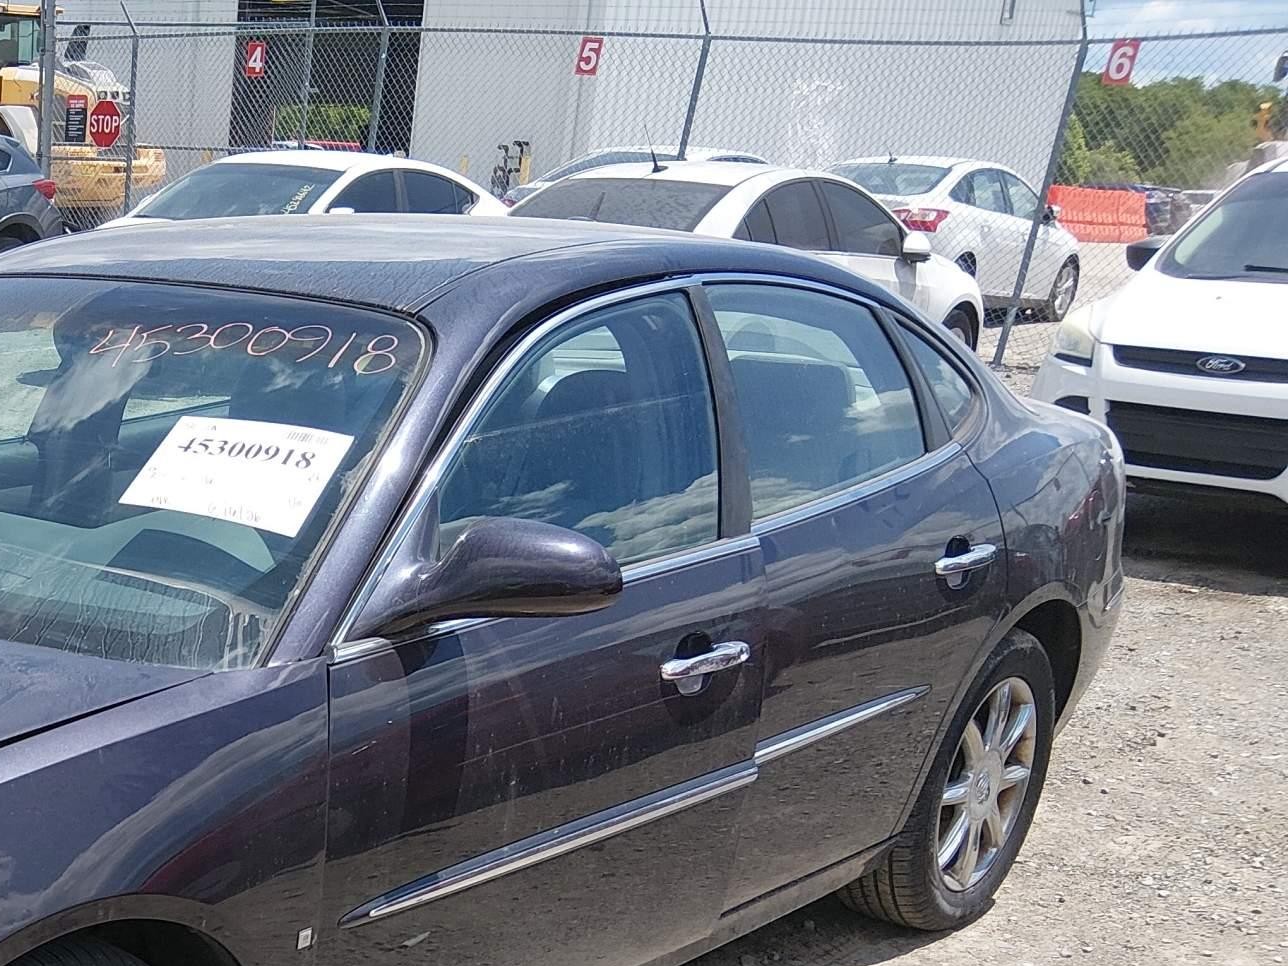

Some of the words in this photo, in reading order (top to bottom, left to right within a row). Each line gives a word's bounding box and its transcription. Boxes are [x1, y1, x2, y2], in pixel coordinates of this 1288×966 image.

[248, 46, 263, 73] 4
[579, 42, 600, 71] 5
[1108, 46, 1134, 80] 6
[90, 114, 120, 133] STOP
[88, 322, 399, 375] 45300918
[1205, 358, 1234, 371] Ford
[177, 437, 316, 470] 45300918
